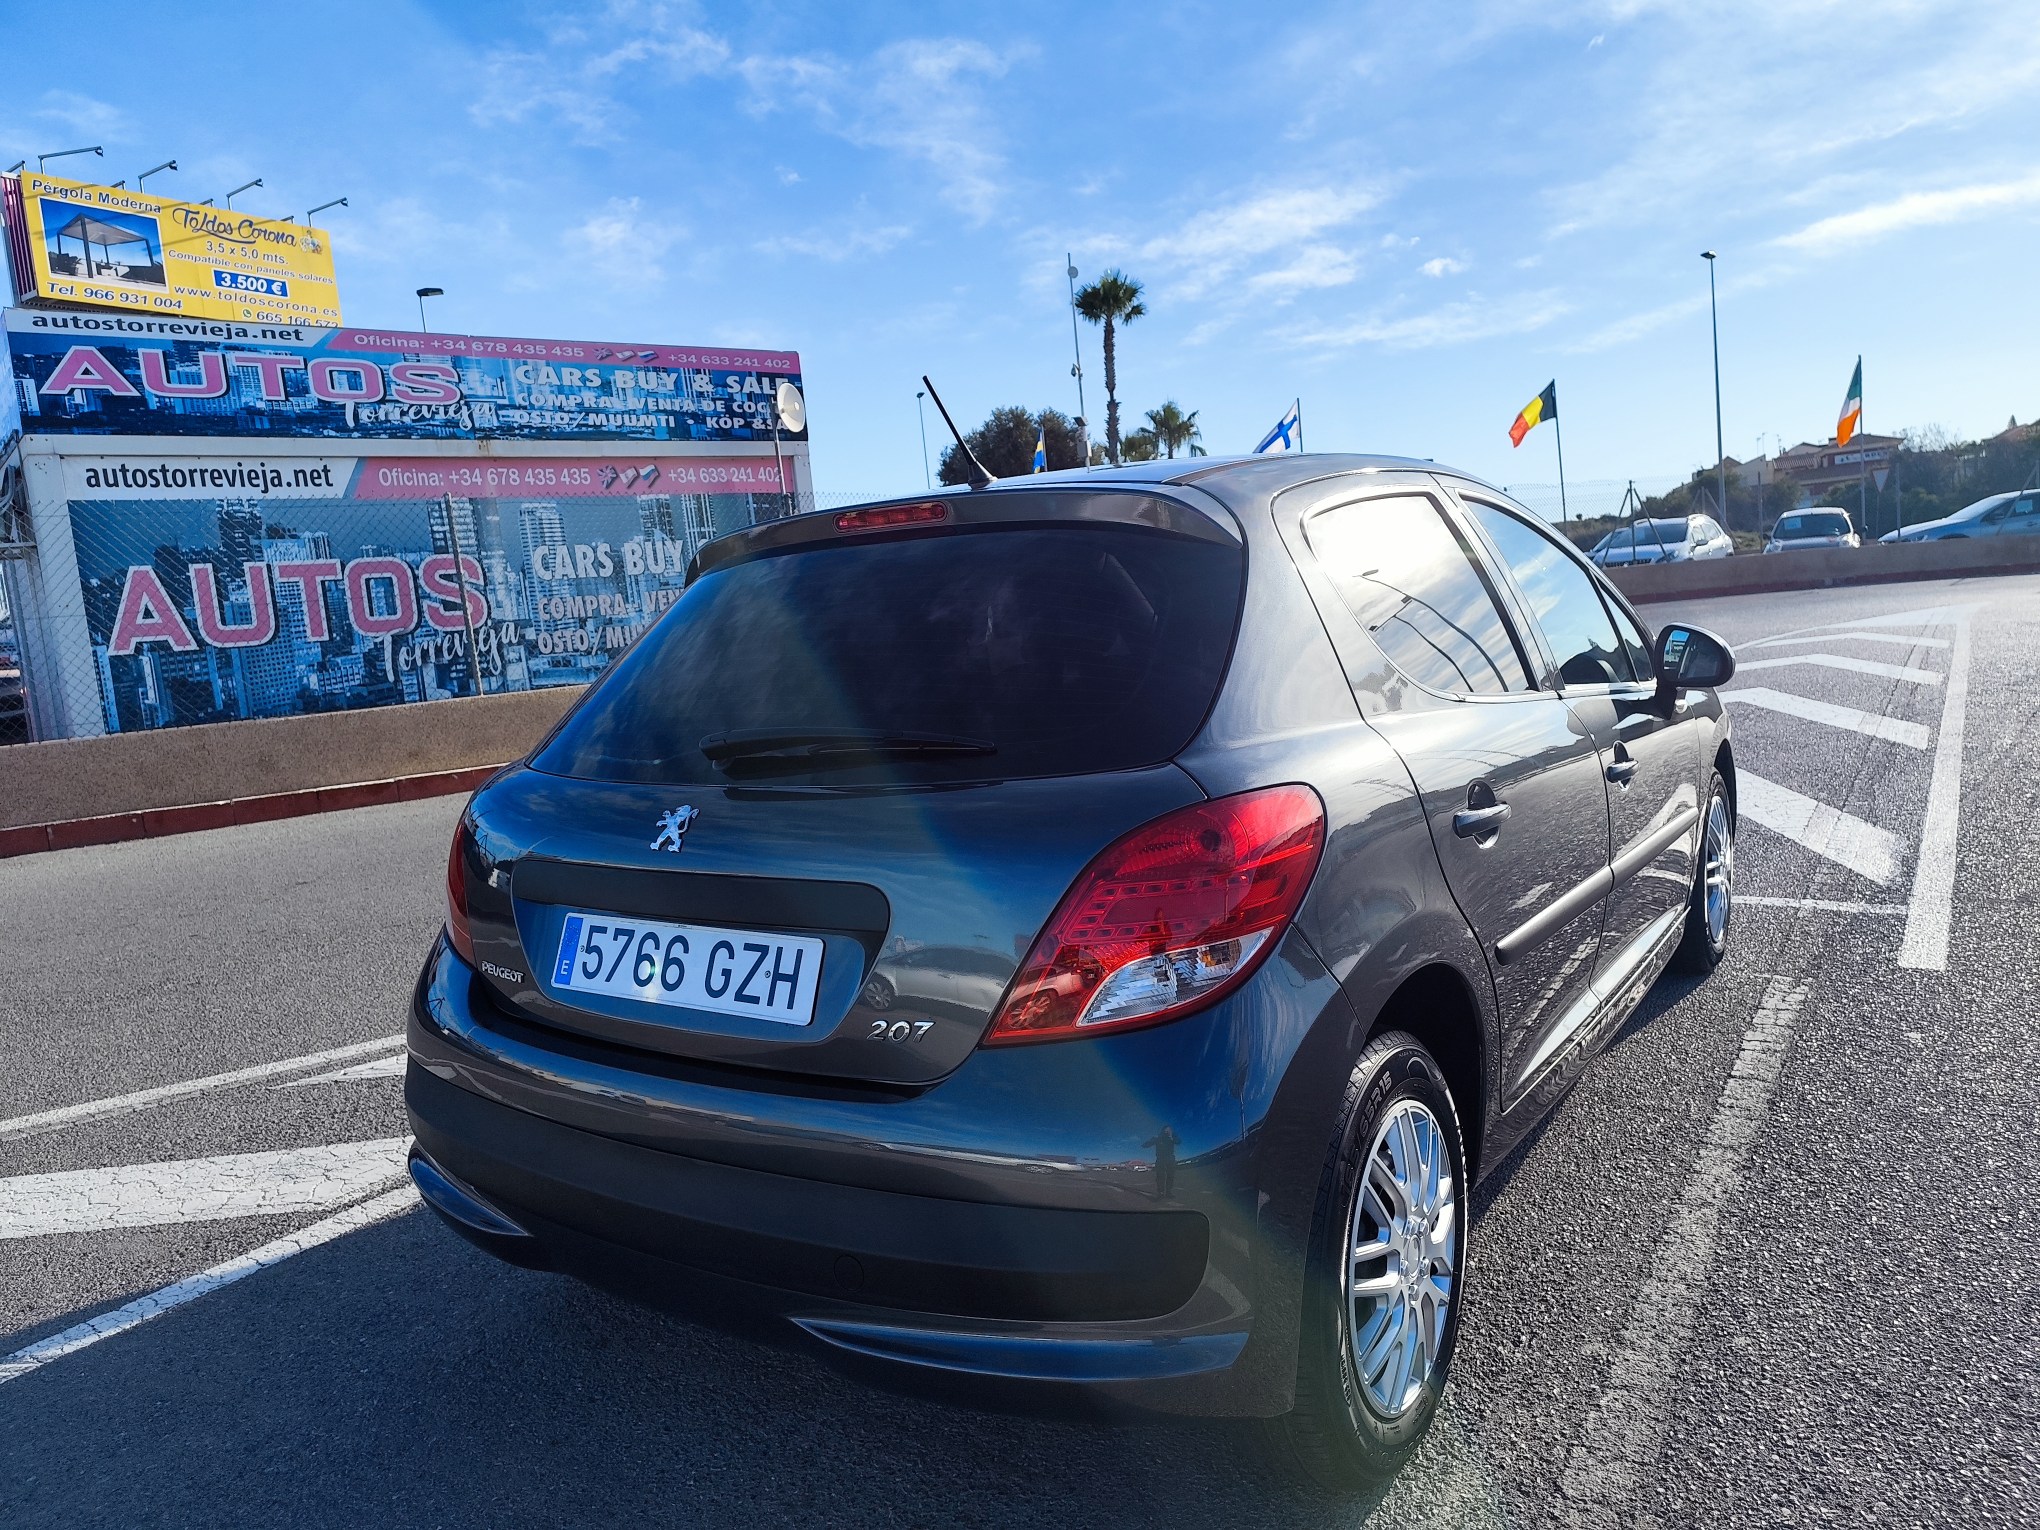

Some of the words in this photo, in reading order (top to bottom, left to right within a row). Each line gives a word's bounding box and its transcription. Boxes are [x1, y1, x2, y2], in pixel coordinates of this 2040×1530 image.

[32, 179, 92, 201] Pérgola
[98, 192, 161, 214] Moderna
[172, 207, 240, 240] Toldos
[238, 219, 297, 248] Corona
[168, 249, 231, 267] Compatible
[234, 261, 253, 270] con
[256, 265, 299, 279] paneles
[298, 273, 333, 285] solares
[206, 241, 225, 255] 3,5
[241, 248, 259, 262] 5,0
[262, 253, 289, 266] mts.
[47, 282, 78, 296] Tel.
[84, 287, 115, 301] 966
[119, 292, 147, 305] 931
[153, 297, 182, 309] 004
[221, 272, 267, 293] 3.500
[271, 281, 283, 295] €
[174, 285, 338, 317] www.toldoscorona.es
[32, 313, 304, 343] autostorrevieja.net
[256, 311, 282, 323] 665
[288, 315, 311, 327] 166
[354, 334, 425, 349] Oficina:
[430, 339, 467, 351] +34
[472, 341, 508, 353] 678
[512, 343, 547, 355] 435
[551, 346, 584, 357] 435
[668, 353, 698, 364] +34
[701, 355, 730, 366] 633
[734, 357, 761, 367] 241
[764, 359, 791, 369] 402
[38, 345, 462, 405] AUTOS
[515, 365, 602, 388] CARS
[615, 370, 678, 391] BUY
[693, 373, 715, 392] &
[340, 397, 496, 431] Torrevieja
[634, 397, 695, 412] VENTA
[703, 400, 726, 413] DE
[706, 414, 745, 429] KÖP
[86, 462, 334, 494] autostorrevieja.net
[378, 466, 444, 487] Oficina:
[448, 468, 482, 486] +34
[487, 468, 520, 486] 678
[524, 468, 556, 486] 435
[560, 467, 591, 485] 435
[668, 467, 696, 484] +34
[700, 467, 727, 483] 633
[730, 467, 755, 482] 241
[758, 466, 781, 482] 402
[533, 543, 614, 581] CARS
[624, 539, 683, 576] BUY
[107, 553, 488, 656] AUTOS
[375, 619, 520, 683] Torreveja
[481, 960, 524, 984] PEUGEOT
[560, 960, 570, 976] E
[581, 925, 690, 992] 5766
[704, 939, 804, 1011] GZH
[866, 1020, 936, 1043] 207
